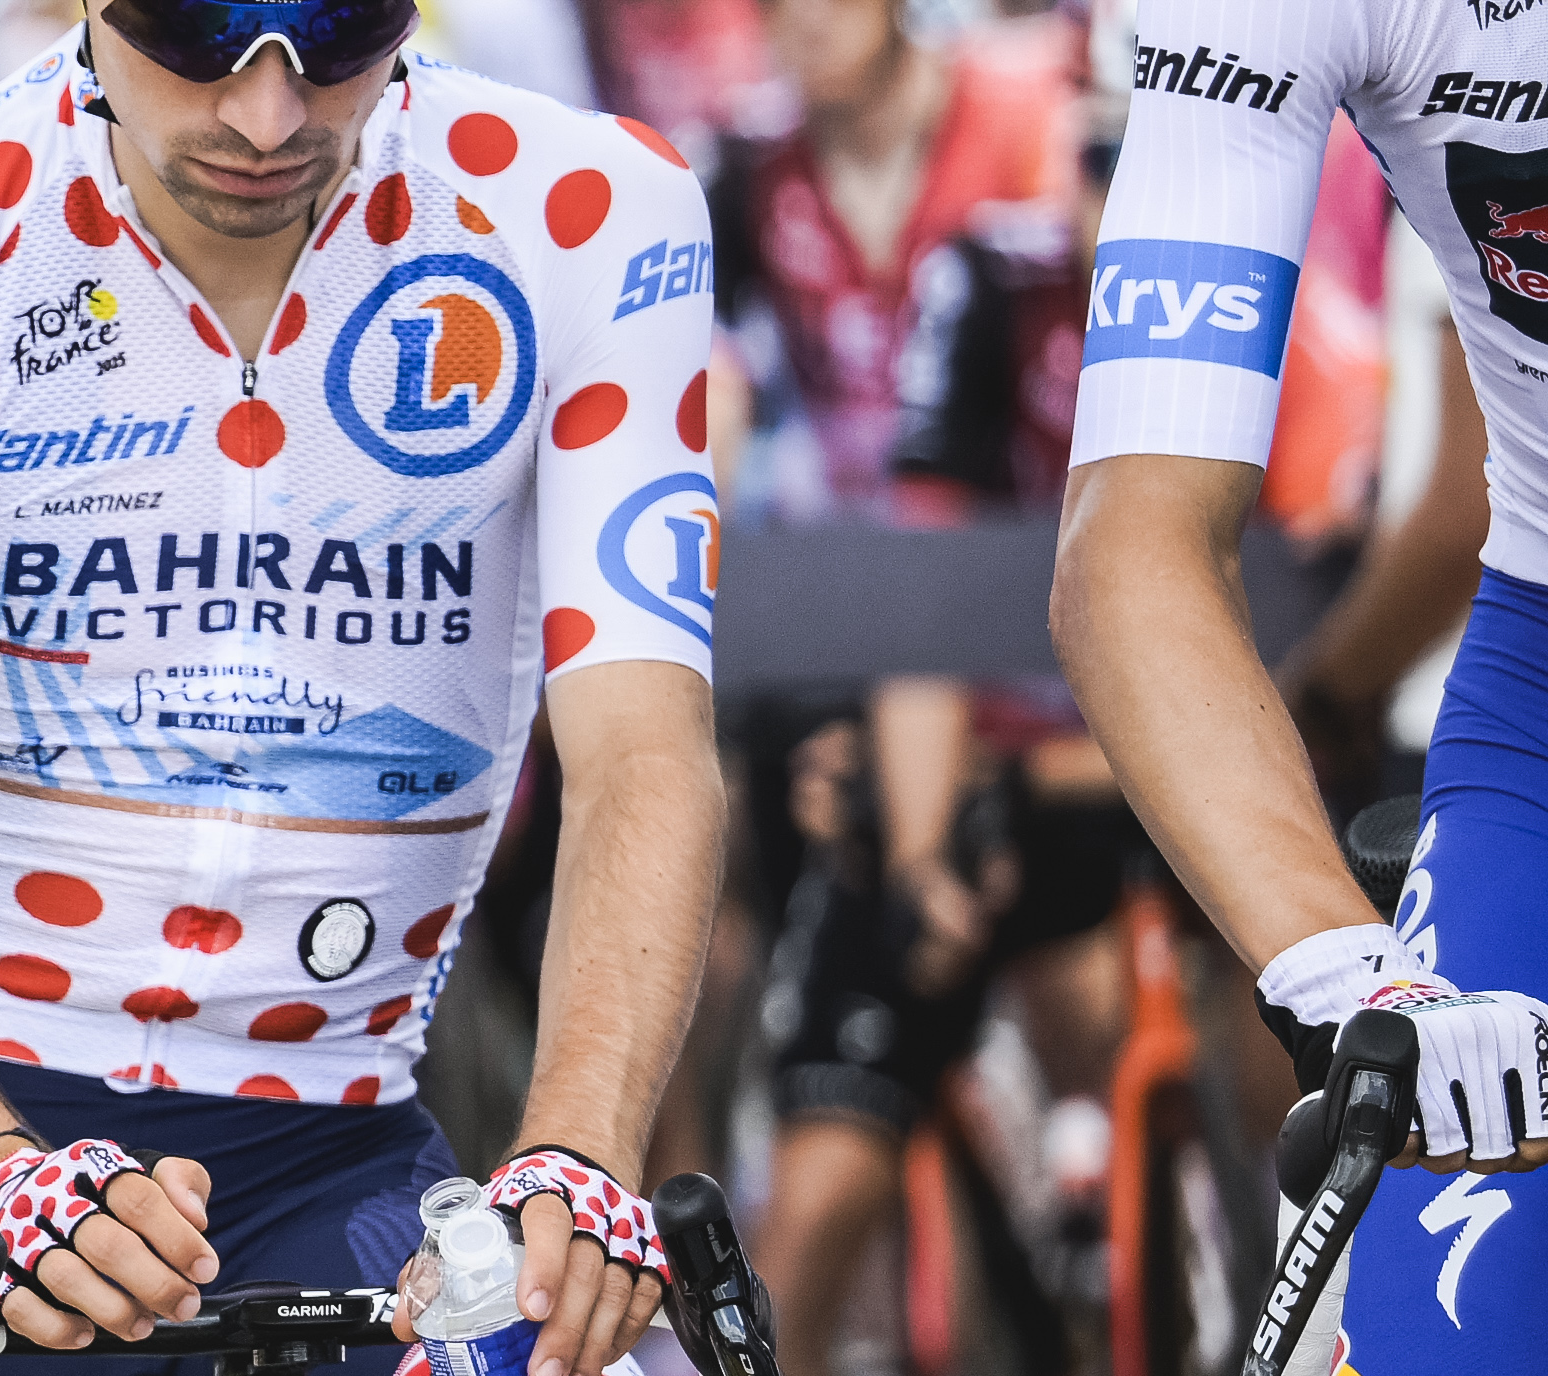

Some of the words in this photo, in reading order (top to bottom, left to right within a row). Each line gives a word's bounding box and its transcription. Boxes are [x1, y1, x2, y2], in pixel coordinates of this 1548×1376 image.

[1134, 33, 1299, 115] antini
[1085, 262, 1262, 343] Krys
[1477, 240, 1548, 303] Re
[40, 490, 165, 518] MARTINEZ
[1, 531, 474, 602] BAHRAIN
[0, 598, 472, 647] VICTORIOUS
[117, 667, 345, 736] friendly
[177, 712, 289, 734] BAHRAIN
[1253, 1189, 1347, 1362] SRAM
[277, 1303, 343, 1317] GARMIN
